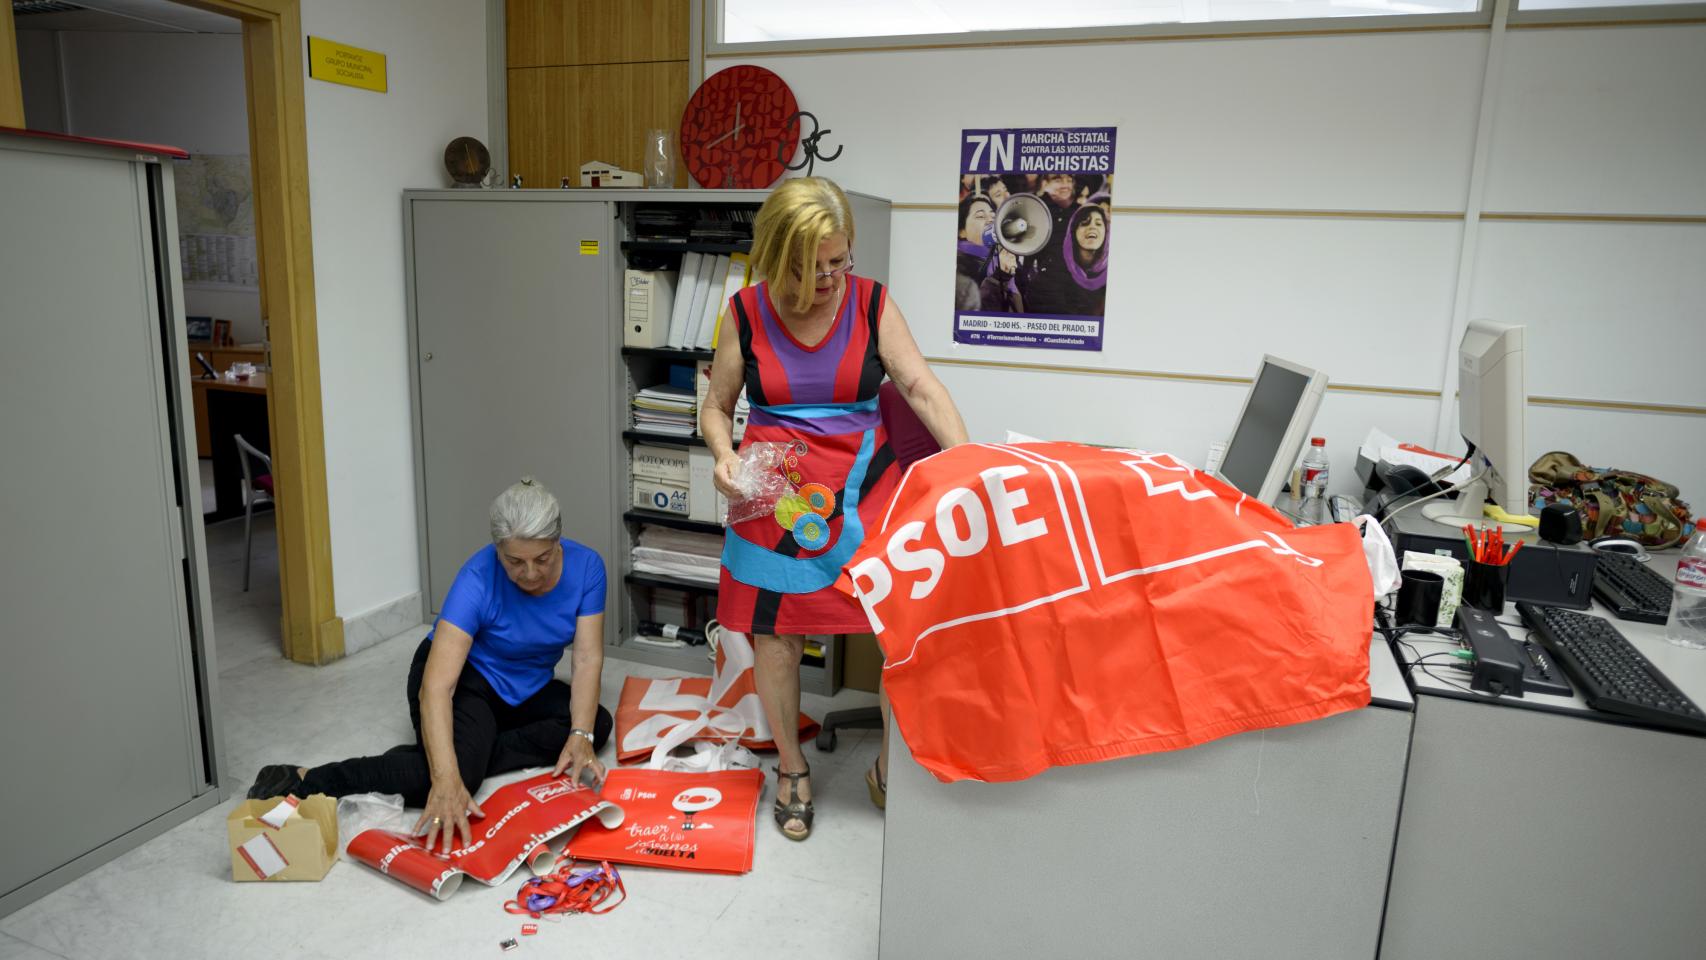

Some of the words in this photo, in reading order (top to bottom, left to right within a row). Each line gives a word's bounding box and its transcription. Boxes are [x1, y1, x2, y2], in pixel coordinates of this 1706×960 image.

[966, 133, 1015, 171] 7N
[1021, 133, 1065, 144] MARCHA
[1067, 132, 1111, 143] ESTATAL
[1021, 145, 1050, 154] CONTRA
[1051, 145, 1066, 154] LAS
[1067, 144, 1110, 153] VIOLENCIAS
[1020, 155, 1109, 172] MACHISTAS
[962, 319, 988, 328] MADRID
[993, 321, 1010, 329] 12:00
[1027, 322, 1048, 331] PASEO
[1048, 323, 1061, 332] DEL
[1062, 323, 1086, 334] PRADO,
[1087, 325, 1096, 333] 18
[671, 490, 687, 500] A4
[849, 464, 1049, 636] PSOE
[450, 840, 486, 858] Tres
[485, 800, 531, 839] Cantos
[624, 822, 670, 838] traer
